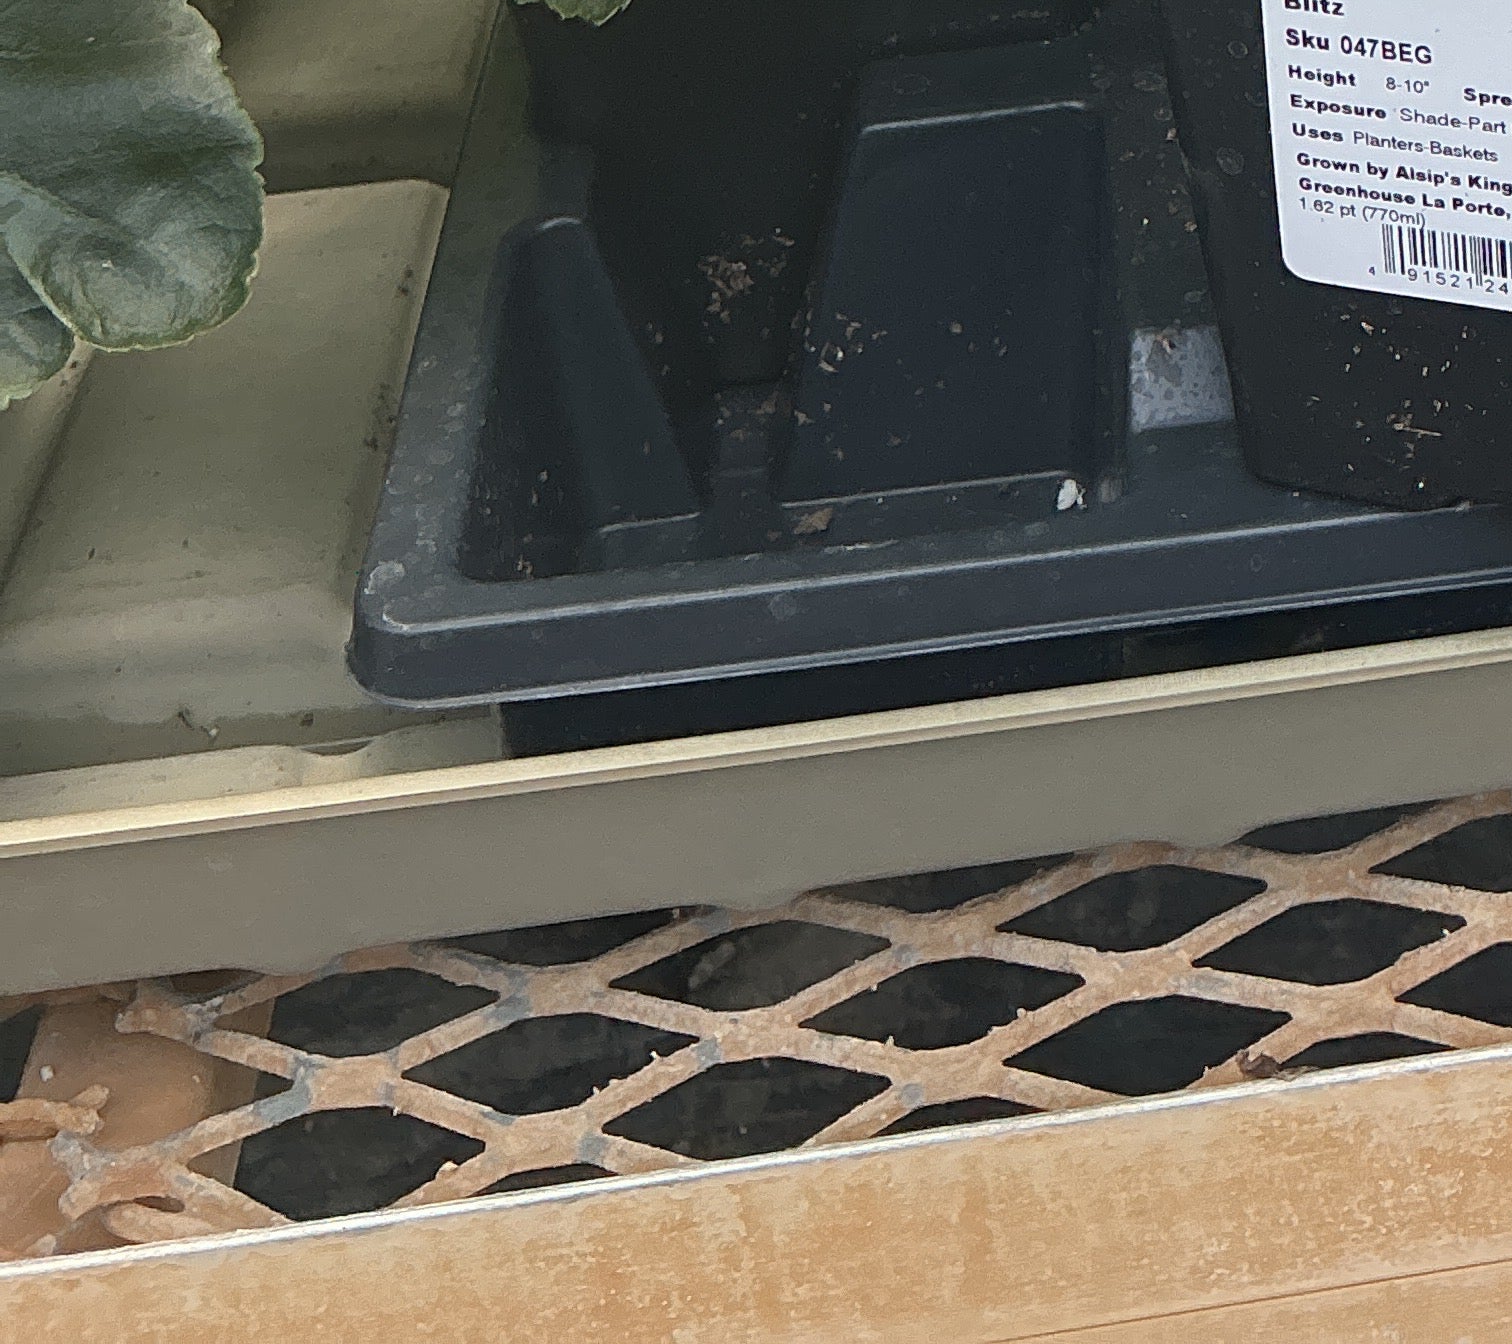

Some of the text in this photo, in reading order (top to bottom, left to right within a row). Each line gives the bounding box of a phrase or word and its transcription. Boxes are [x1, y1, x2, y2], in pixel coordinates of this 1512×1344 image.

[1285, 28, 1432, 64] Sku 047BEG
[1288, 65, 1356, 87] Height
[1386, 77, 1429, 93] 8-10"
[1290, 94, 1387, 119] Exposure
[1399, 108, 1506, 134] Shade-Part
[1292, 123, 1498, 162] Uses Planters-Baskets
[1297, 152, 1360, 174] Grown
[1367, 162, 1389, 180] by
[1396, 166, 1461, 187] Alsip's
[1299, 177, 1416, 205] Greenhouse
[1422, 194, 1445, 208] La
[1452, 197, 1511, 220] Porte,
[1299, 197, 1426, 228] 1.62 pt (770ml)
[1368, 266, 1376, 276] 4
[1407, 268, 1474, 289] 91521
